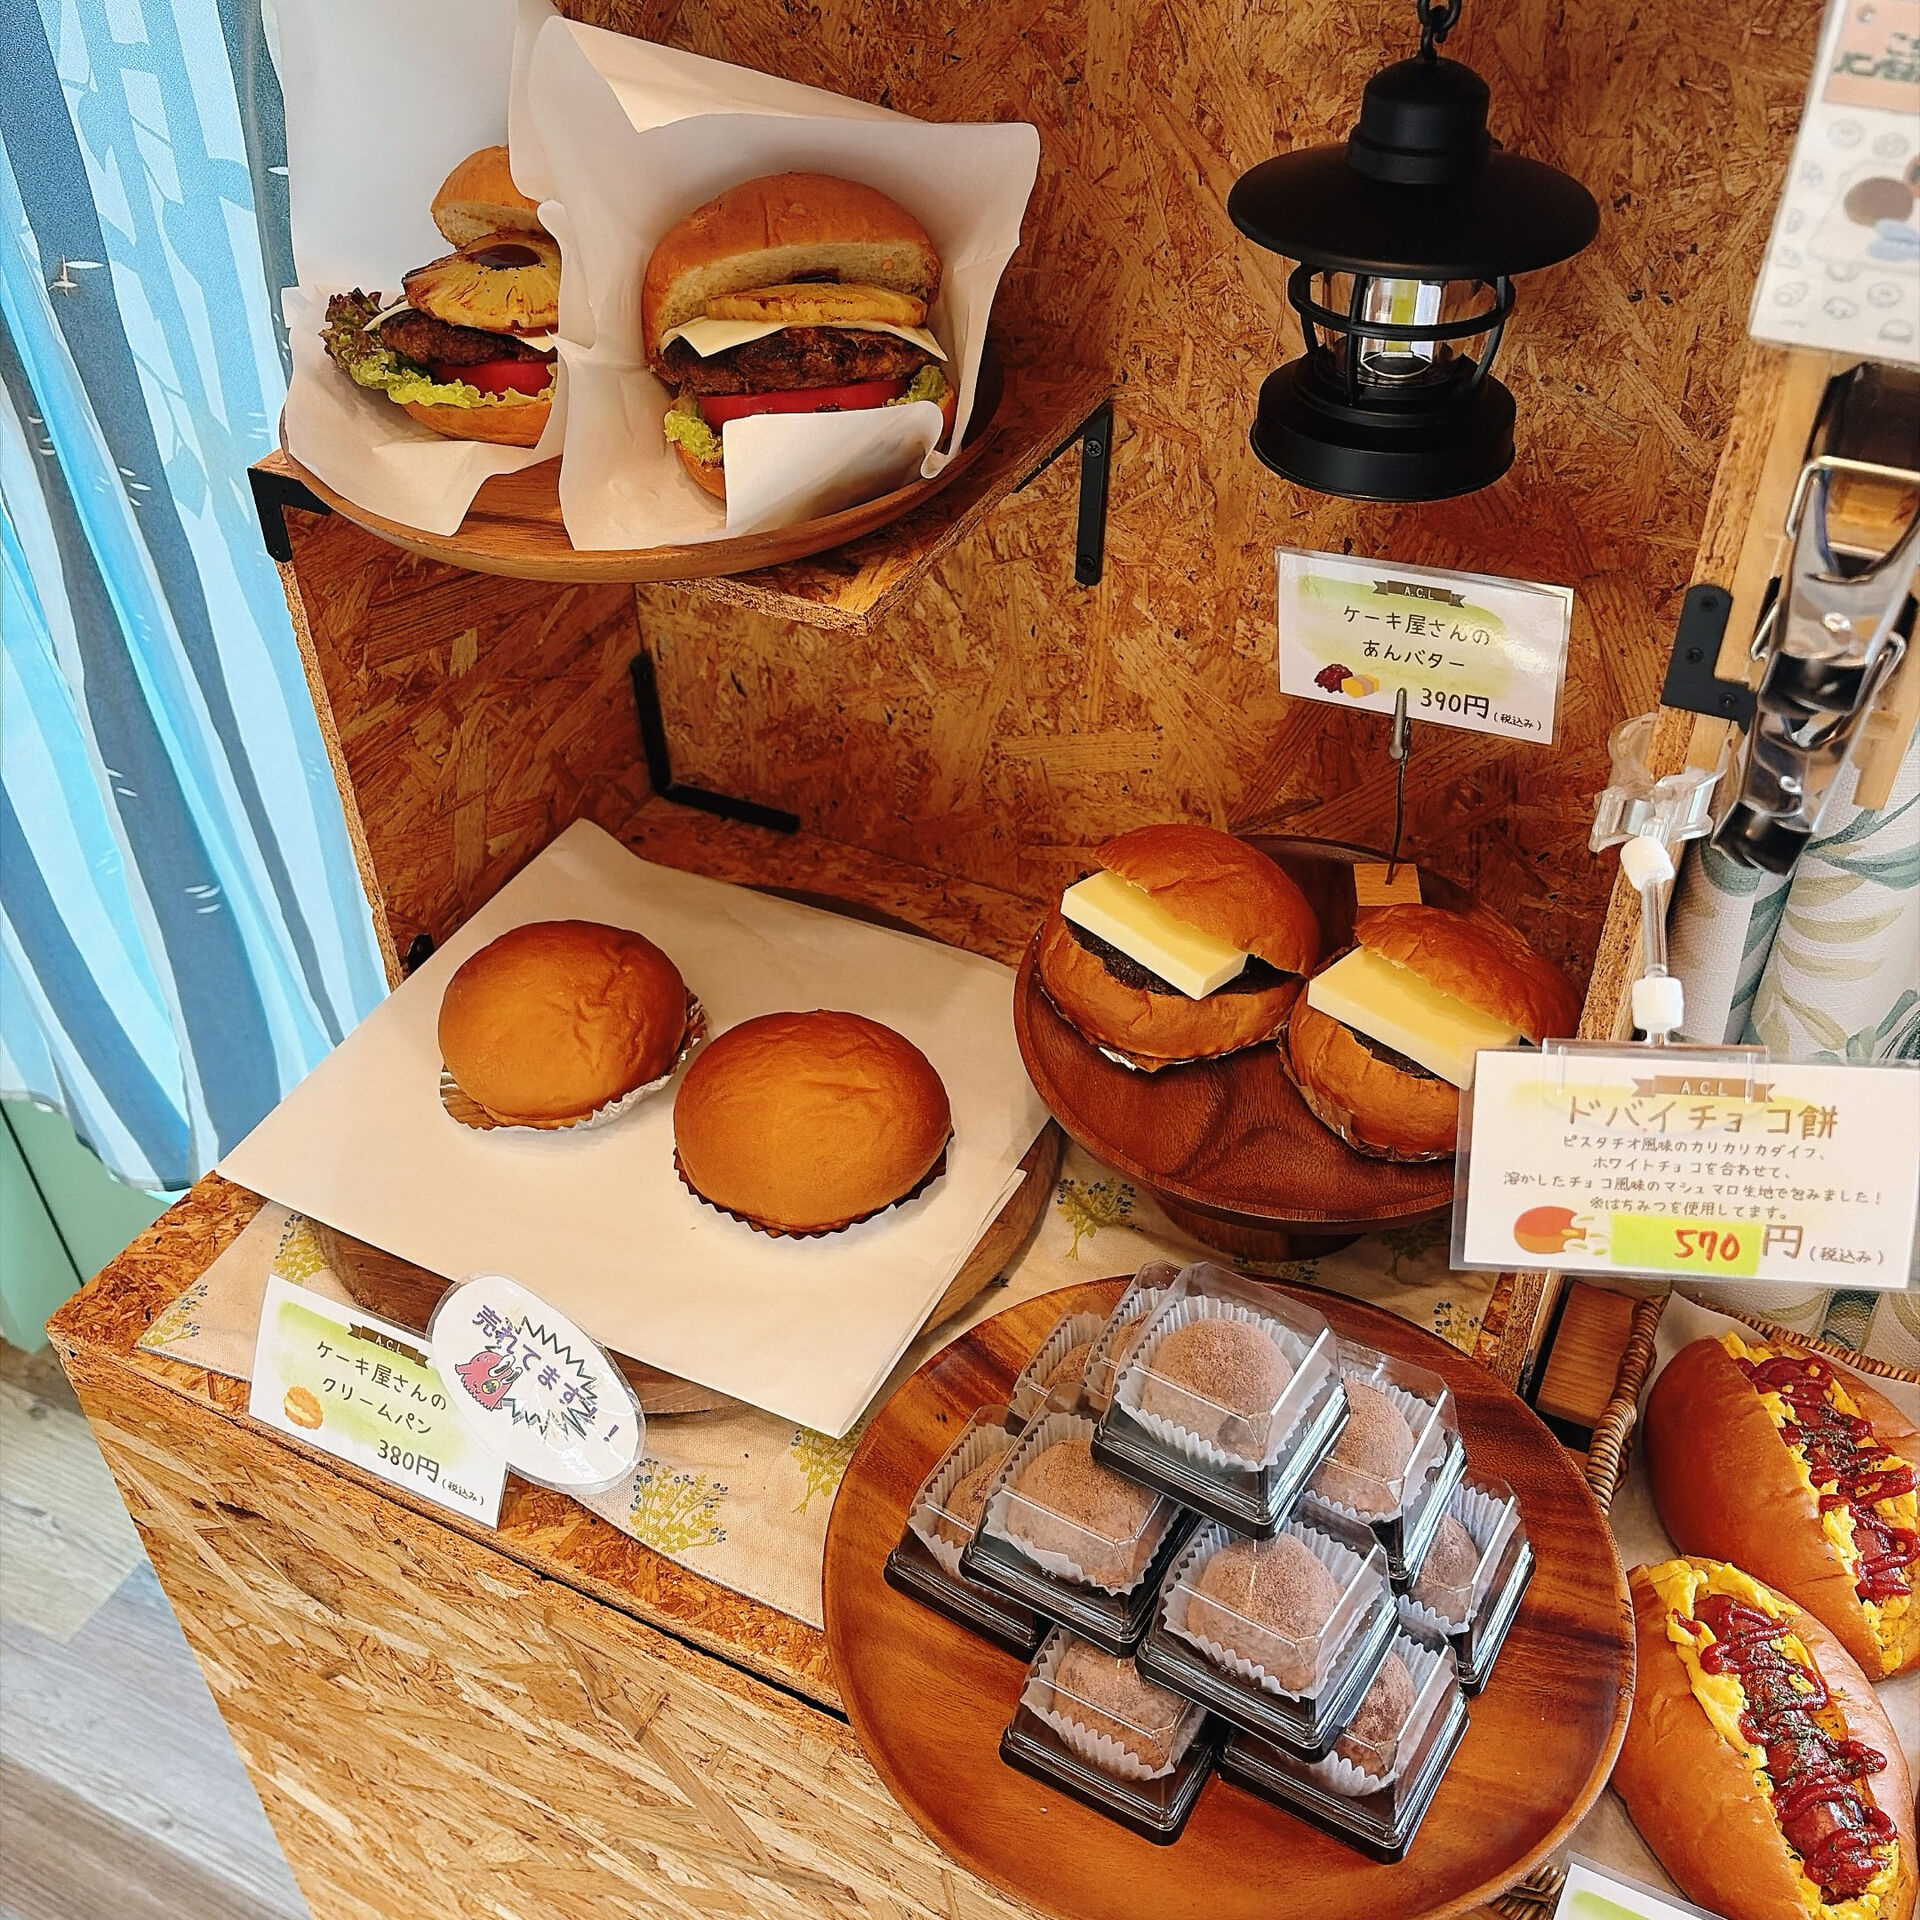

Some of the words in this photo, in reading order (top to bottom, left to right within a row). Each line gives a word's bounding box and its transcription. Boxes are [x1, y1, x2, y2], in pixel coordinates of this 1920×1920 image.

[1404, 586, 1435, 600] A.C.L
[1343, 605, 1490, 645] ケーキ屋さんの
[1362, 639, 1466, 669] あんバター
[1420, 688, 1490, 719] 390円
[1681, 1079, 1728, 1097] A.C.L
[1567, 1095, 1838, 1140] ドバイチョコ餅
[1593, 1156, 1791, 1180] ホワイトチョコを合わせて、
[375, 1334, 403, 1355] A.C.L
[317, 1340, 447, 1411] ケーキ屋さんの
[322, 1377, 432, 1434] クリームパン
[377, 1438, 440, 1484] 380円
